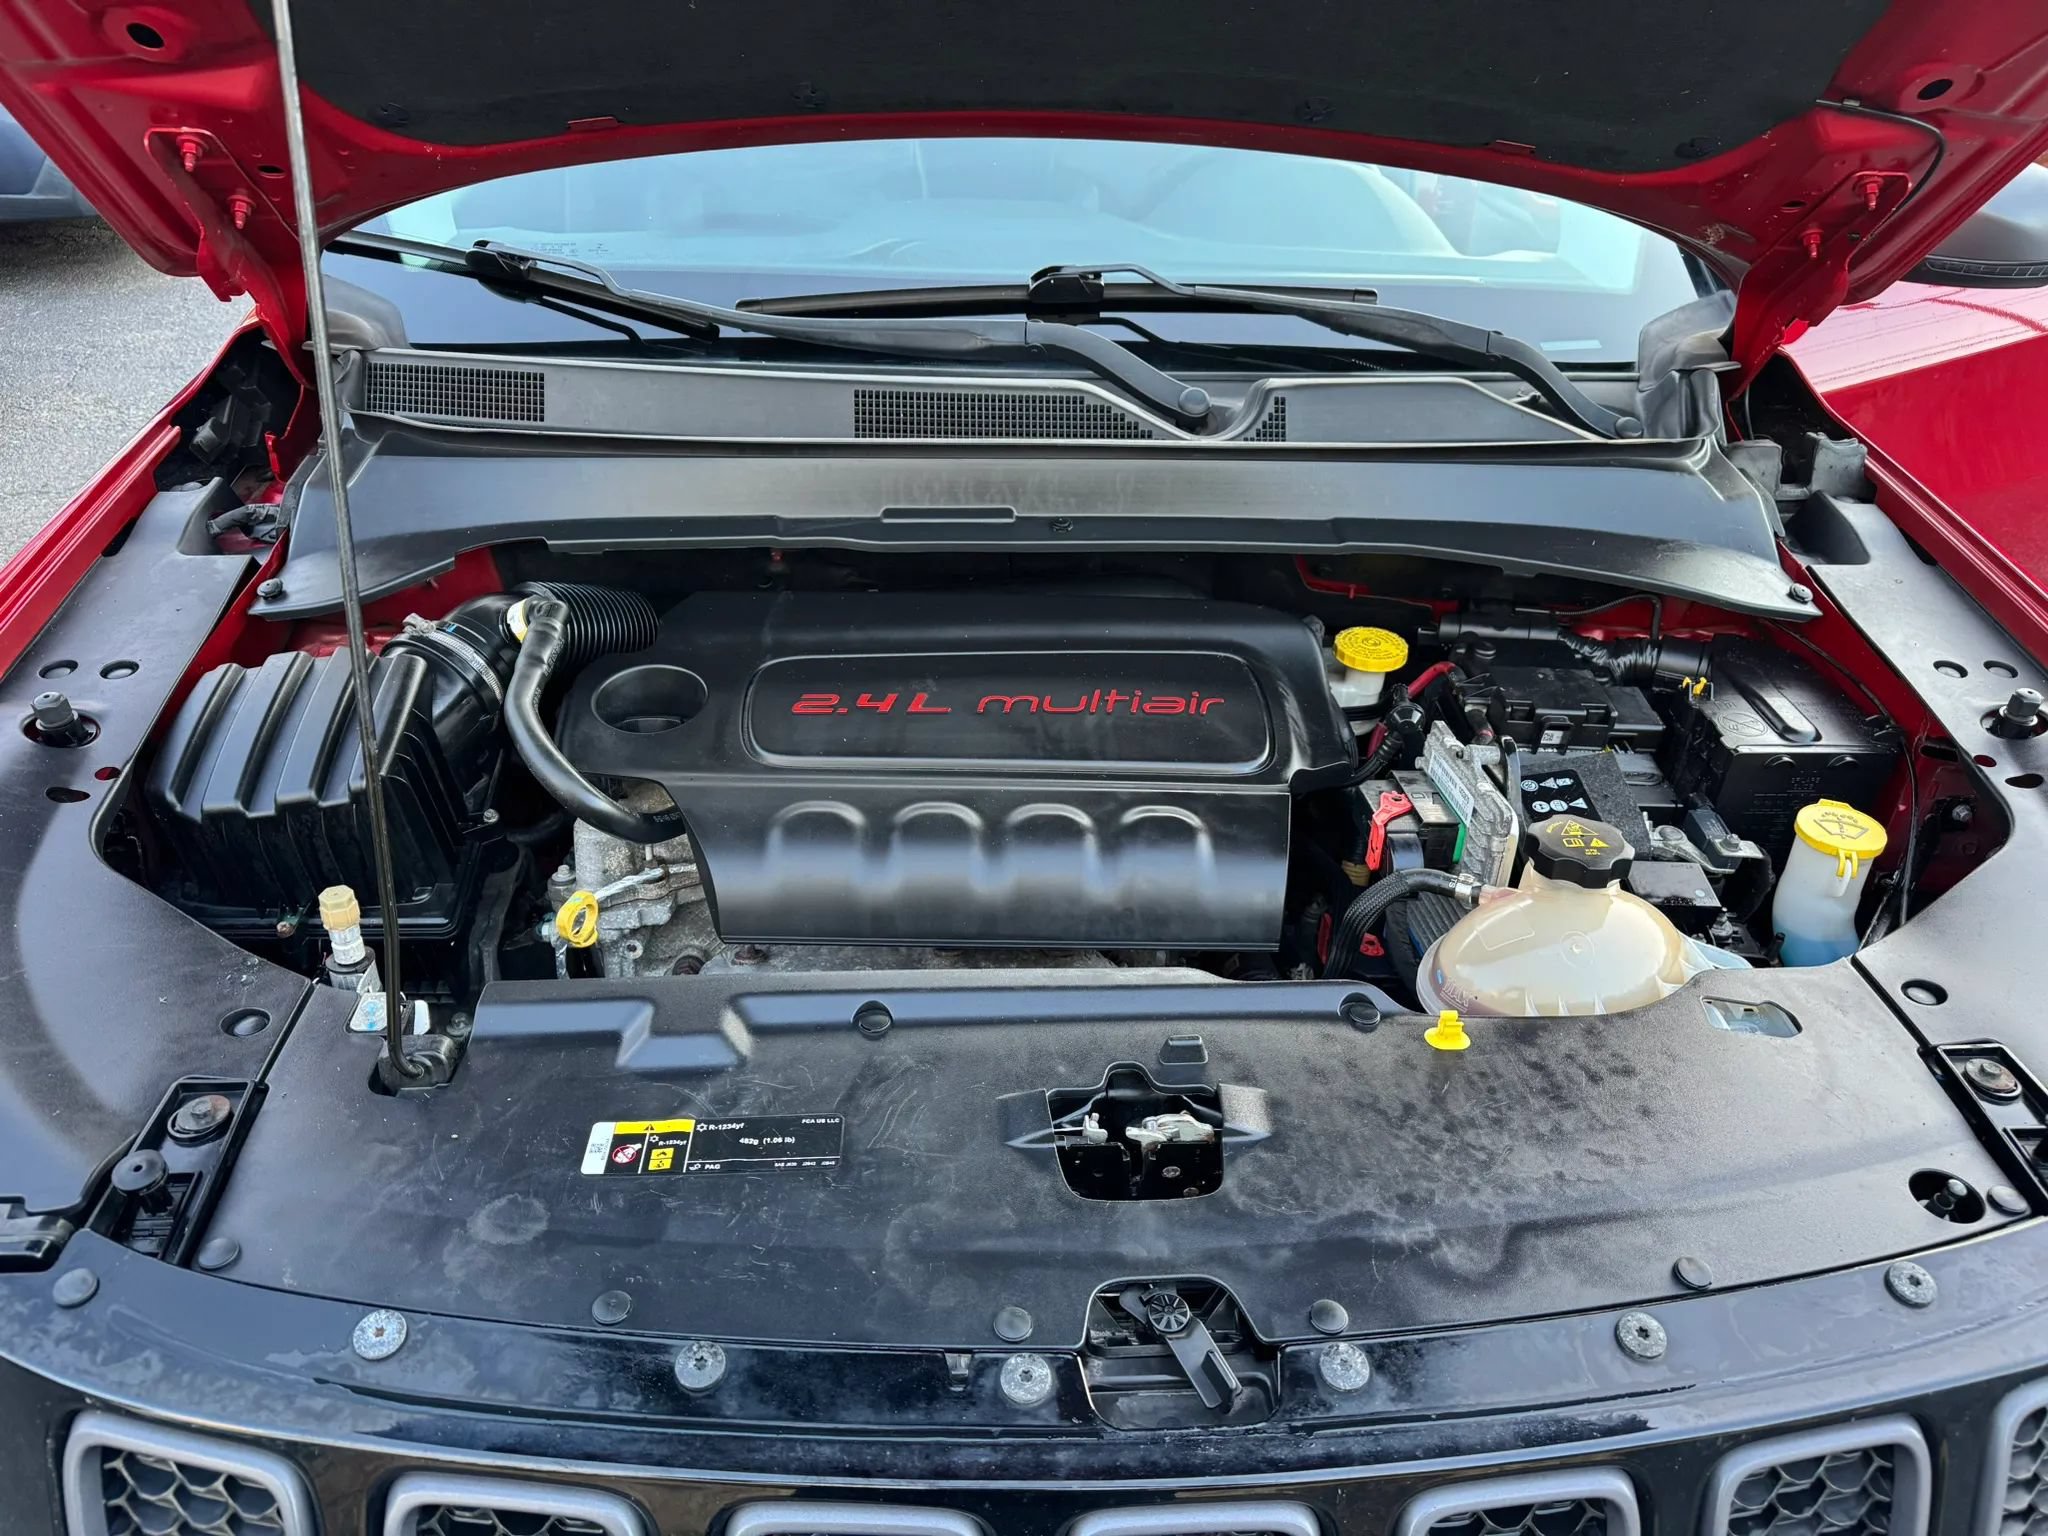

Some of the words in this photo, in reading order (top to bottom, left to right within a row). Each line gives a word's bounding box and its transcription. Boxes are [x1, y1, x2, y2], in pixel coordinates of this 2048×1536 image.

[976, 689, 1225, 716] multiair
[708, 1122, 745, 1131] R-1234yf
[784, 1136, 796, 1144] lb)
